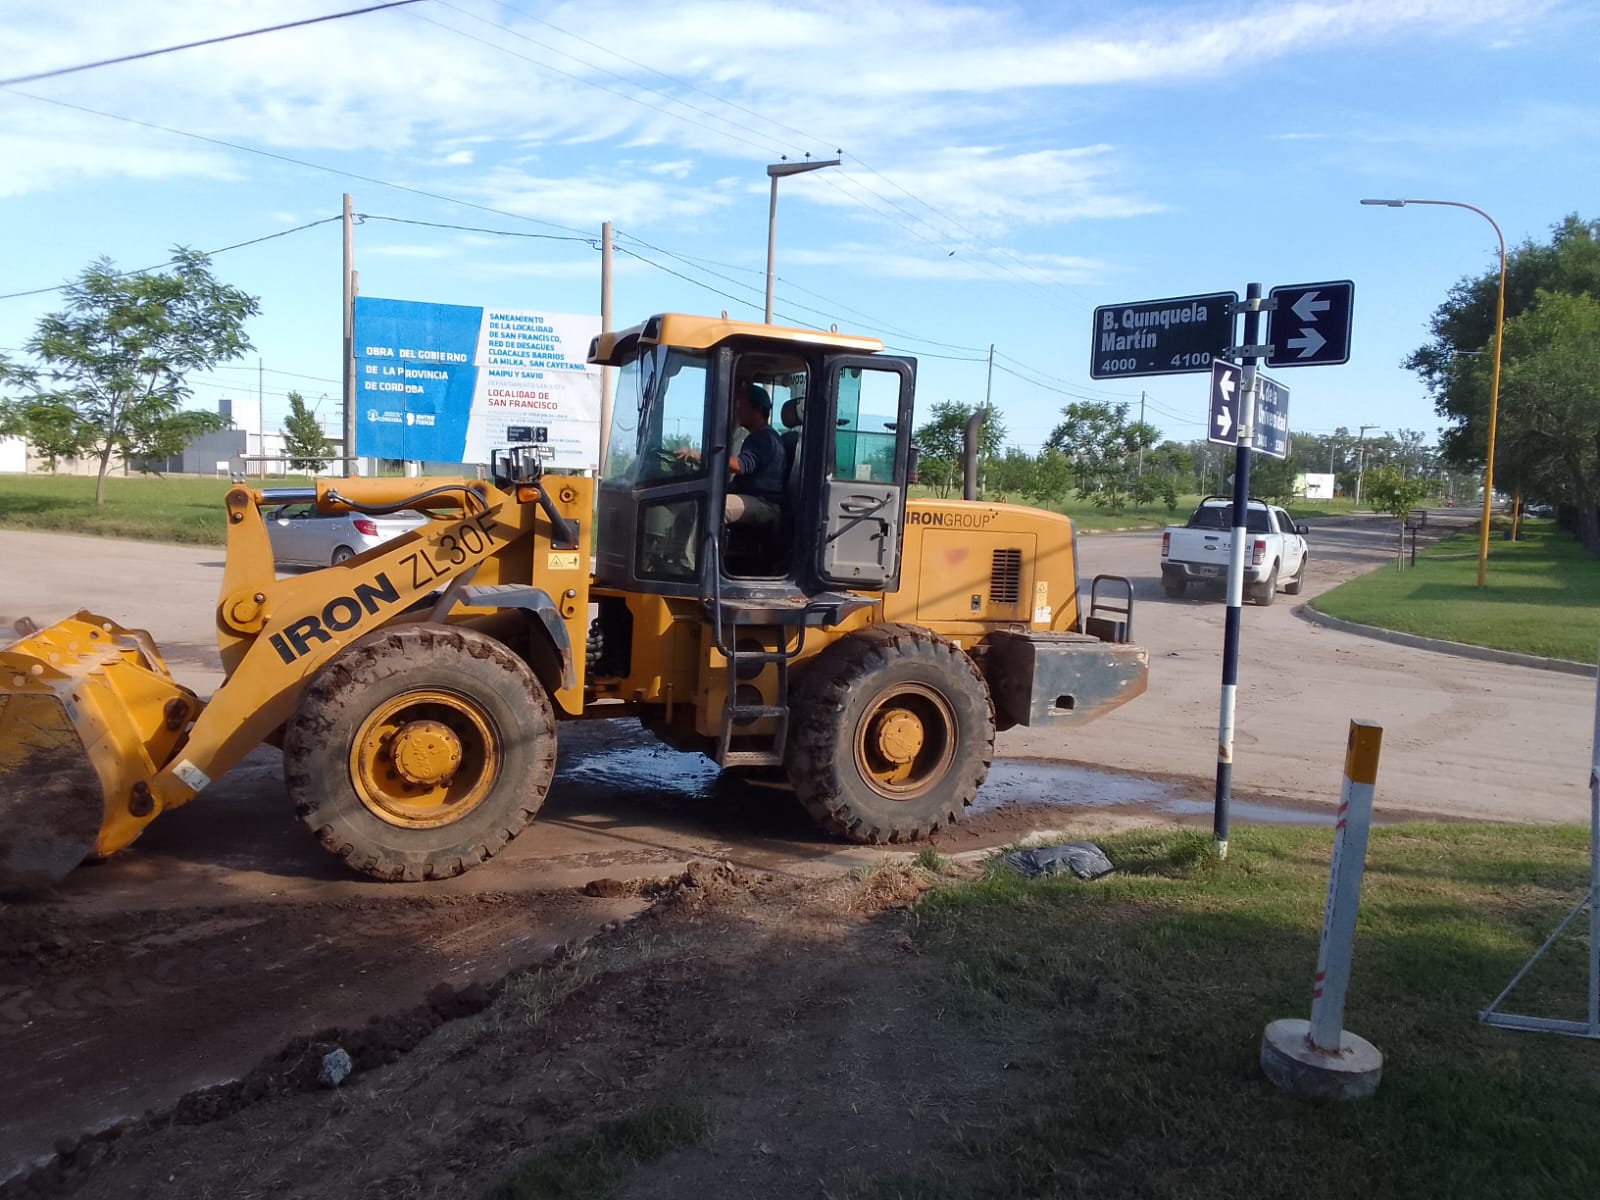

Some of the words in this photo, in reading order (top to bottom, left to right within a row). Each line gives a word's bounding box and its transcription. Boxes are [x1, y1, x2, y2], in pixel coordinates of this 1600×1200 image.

[489, 313, 544, 323] SANEAMIENTO
[1102, 311, 1119, 330] B.
[1122, 303, 1208, 329] Quinquela
[512, 324, 553, 333] LOCALIDAD
[517, 333, 562, 343] FRANCISCO,
[1101, 328, 1157, 352] Martín
[366, 346, 394, 357] OBRA
[399, 349, 416, 359] DEL
[418, 350, 467, 362] GOBIERNO
[488, 349, 530, 358] CLOACALES
[531, 351, 565, 360] BARRIOS
[500, 358, 526, 367] MILKA,
[546, 361, 586, 371] CAYETANO,
[1101, 358, 1137, 372] 4000
[1170, 352, 1210, 368] 4100
[365, 365, 378, 374] DE
[382, 366, 396, 376] LA
[397, 367, 449, 380] PROVINCIA
[488, 369, 513, 378] MAIPU
[521, 371, 544, 379] SAVIO
[364, 381, 377, 390] DE
[379, 382, 424, 394] CORDOBA
[488, 389, 536, 399] LOCALIDAD
[538, 392, 550, 400] DE
[488, 398, 507, 407] SAN
[509, 399, 558, 410] FRANCISCO
[268, 572, 400, 665] IRON
[399, 509, 499, 590] ZL30F
